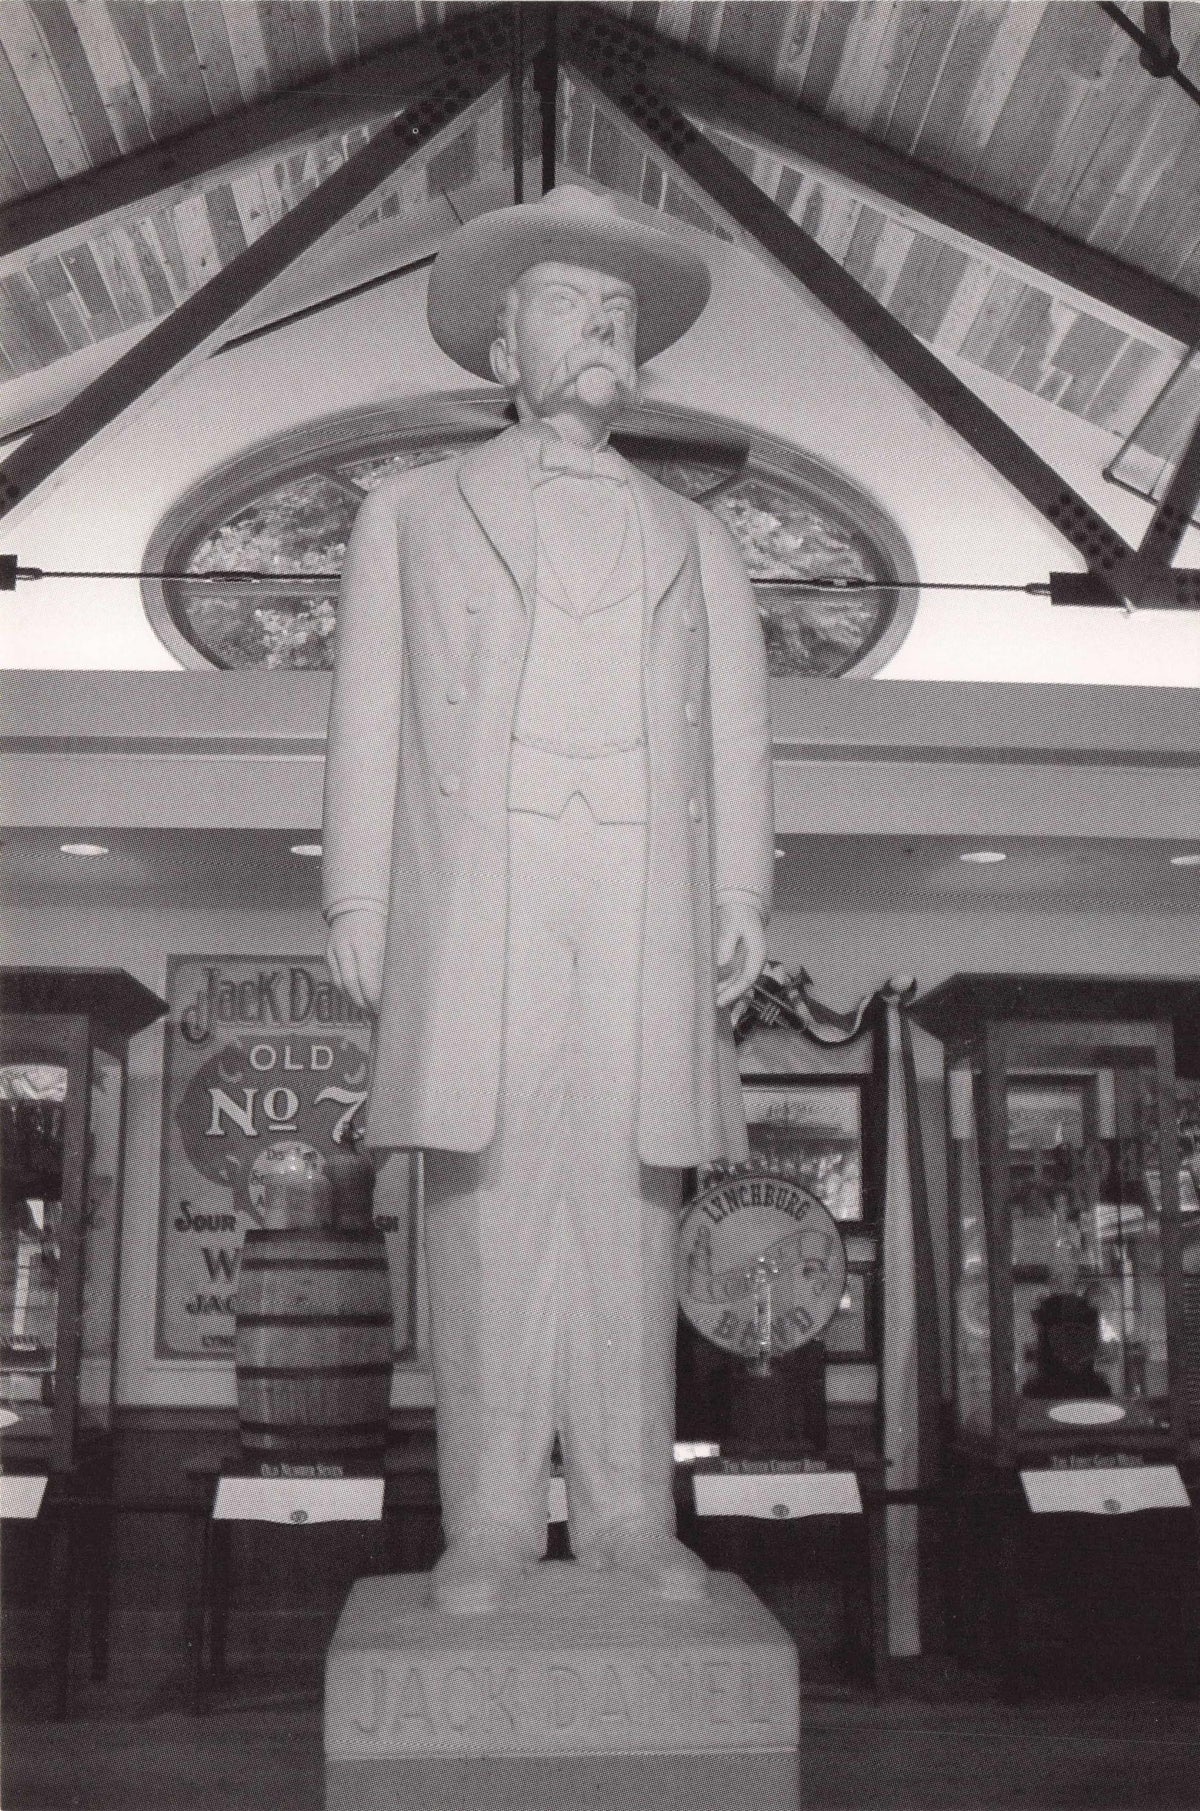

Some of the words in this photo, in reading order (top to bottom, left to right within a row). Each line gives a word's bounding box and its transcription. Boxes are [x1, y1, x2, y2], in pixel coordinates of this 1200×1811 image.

[180, 967, 283, 1045] Jack
[249, 1043, 334, 1071] OLD
[313, 1086, 368, 1144] 7
[174, 1201, 237, 1233] SOUR
[702, 1183, 811, 1225] LYNCHBURG
[186, 1295, 236, 1317] JAC
[712, 1305, 815, 1348] BAND
[352, 1665, 517, 1736] JACK
[546, 1660, 773, 1731] DANIEL
